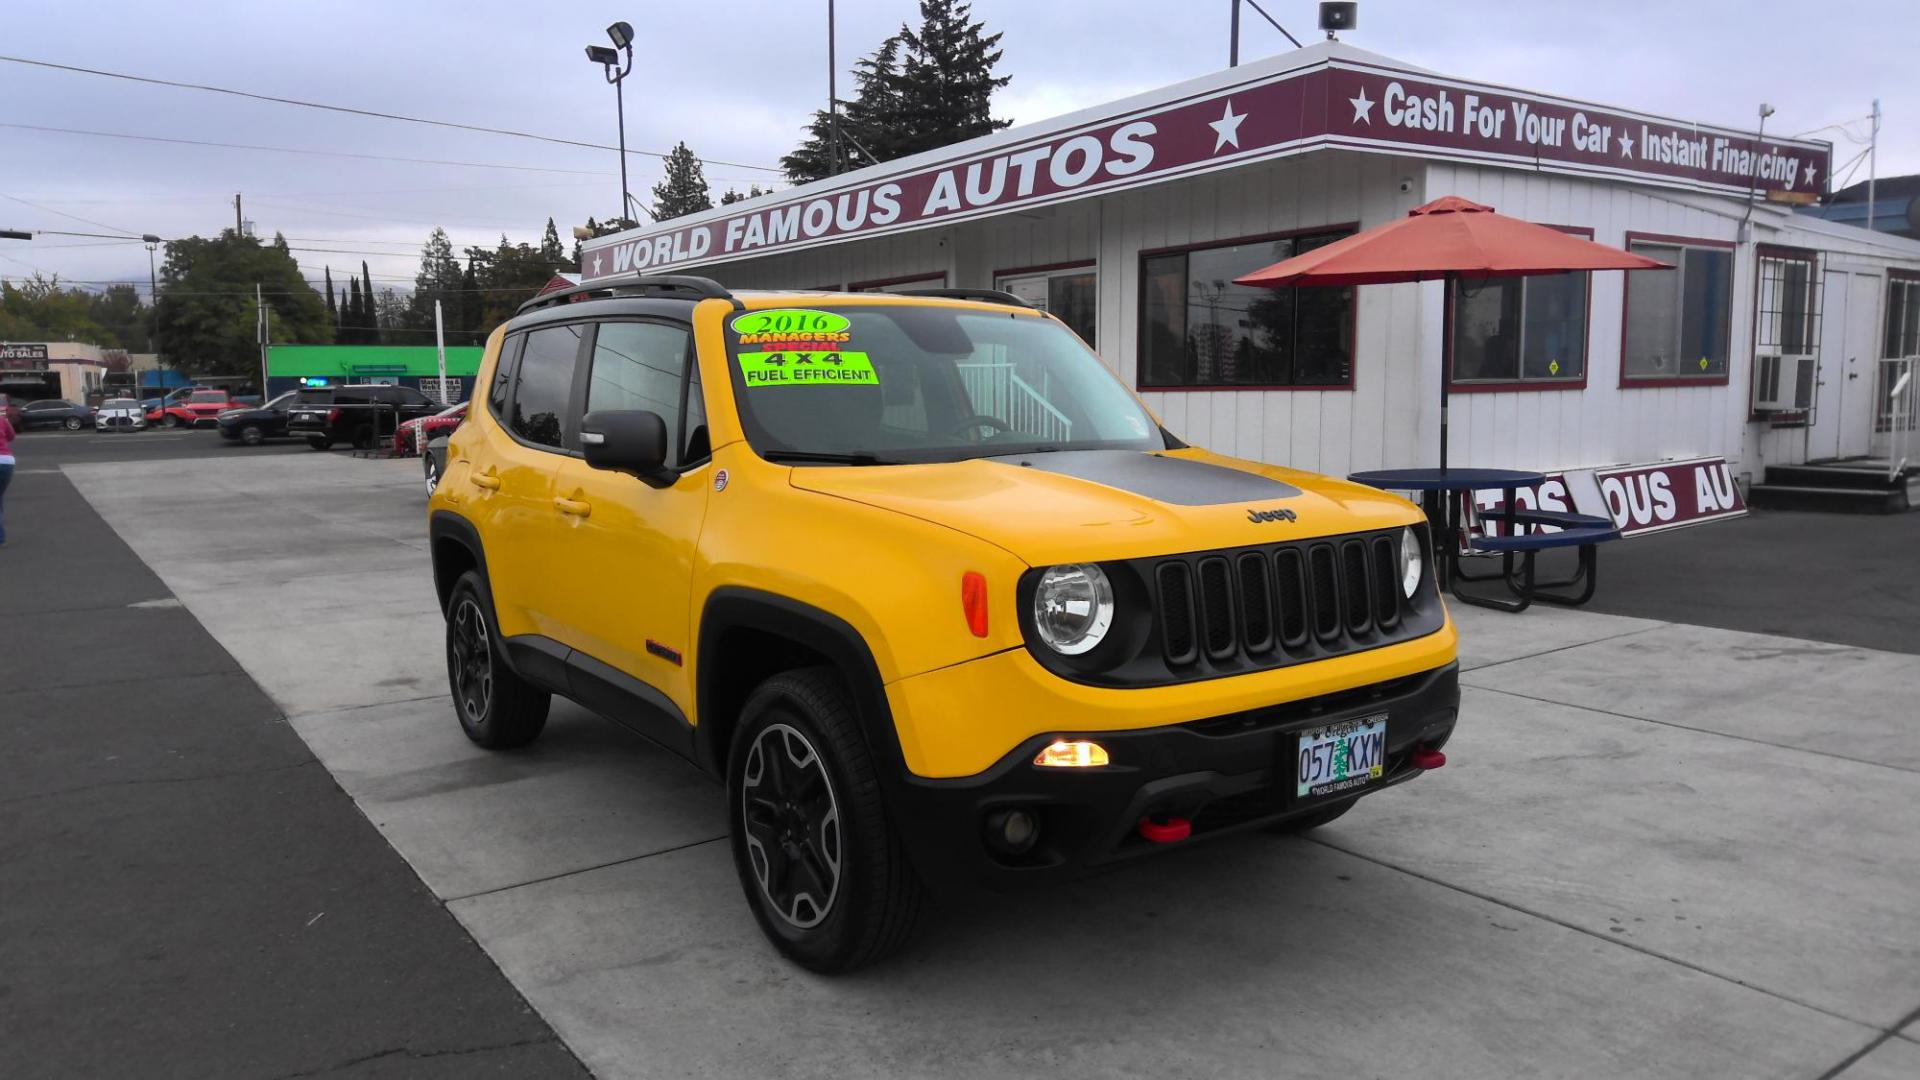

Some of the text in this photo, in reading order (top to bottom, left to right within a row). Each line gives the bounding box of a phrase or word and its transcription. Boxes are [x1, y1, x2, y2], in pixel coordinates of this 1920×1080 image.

[1383, 81, 1799, 190] Cash For Your Car Instant Financing
[611, 121, 1158, 274] WORLD FAMOUS AUTOS
[739, 332, 851, 345] MANAGERS
[757, 315, 828, 333] 2016
[748, 369, 871, 382] FUEL EFFICIENT
[1601, 471, 1677, 529] OUS
[1694, 463, 1736, 514] AU
[1247, 509, 1297, 523] Jeep
[1300, 731, 1384, 783] 057 KXM
